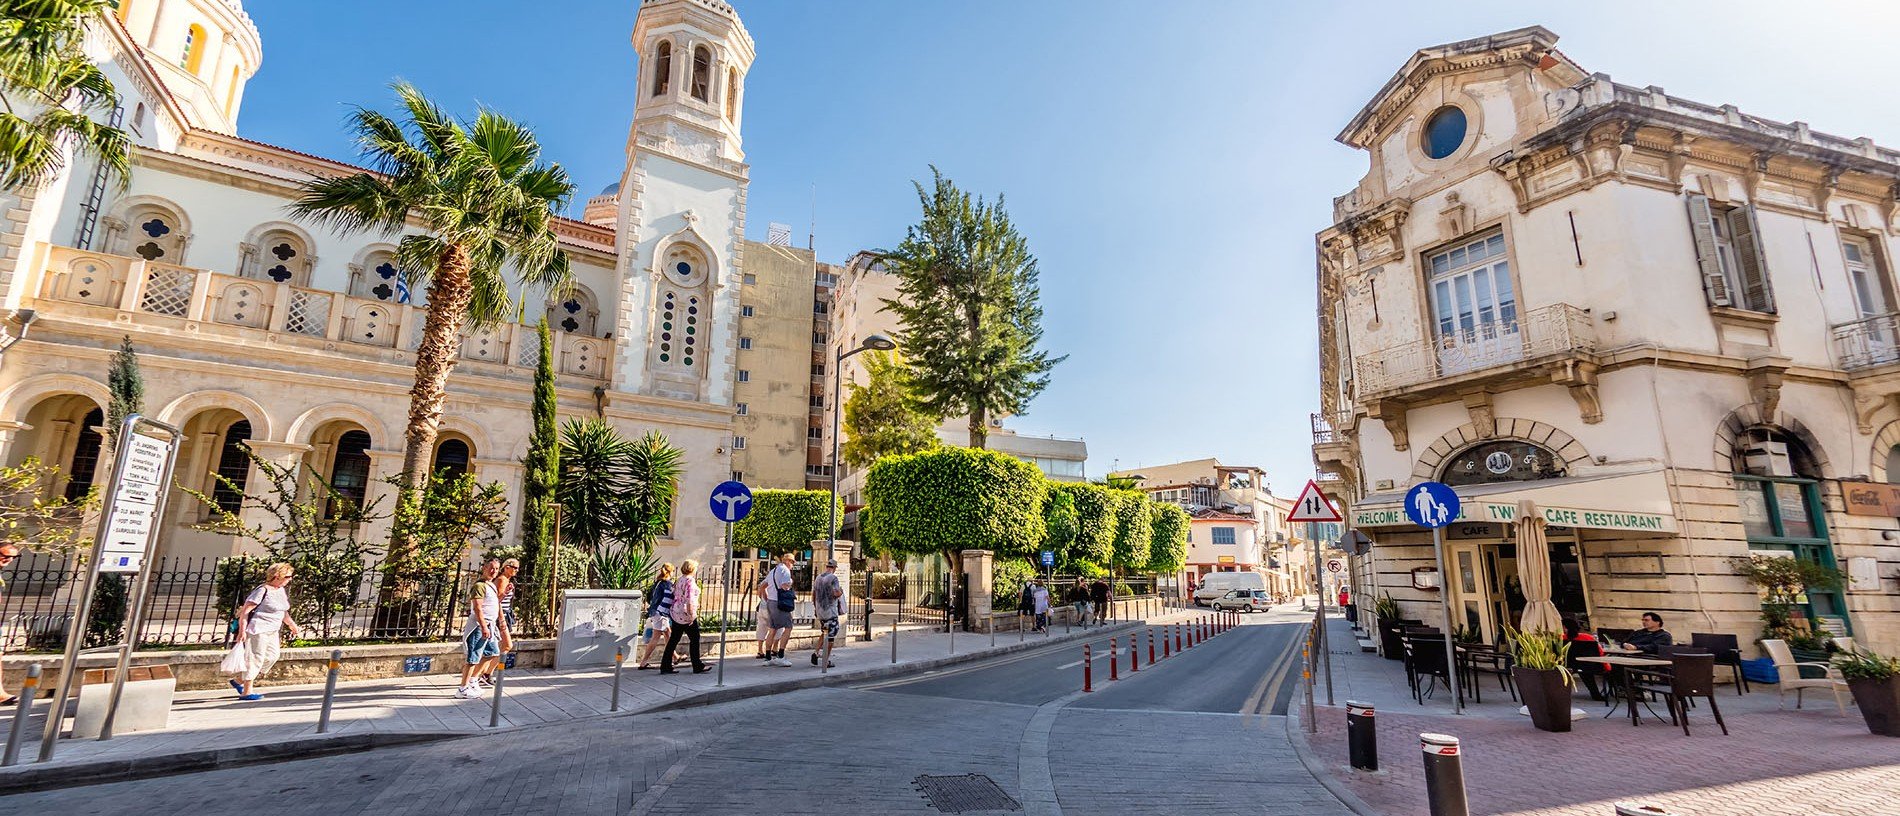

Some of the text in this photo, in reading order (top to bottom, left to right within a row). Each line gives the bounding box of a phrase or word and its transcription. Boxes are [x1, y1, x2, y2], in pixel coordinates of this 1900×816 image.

[1357, 511, 1399, 524] WELCOME
[1545, 508, 1578, 524] CAFE
[1584, 512, 1662, 530] RESTAURANT
[1462, 526, 1489, 535] CAFE
